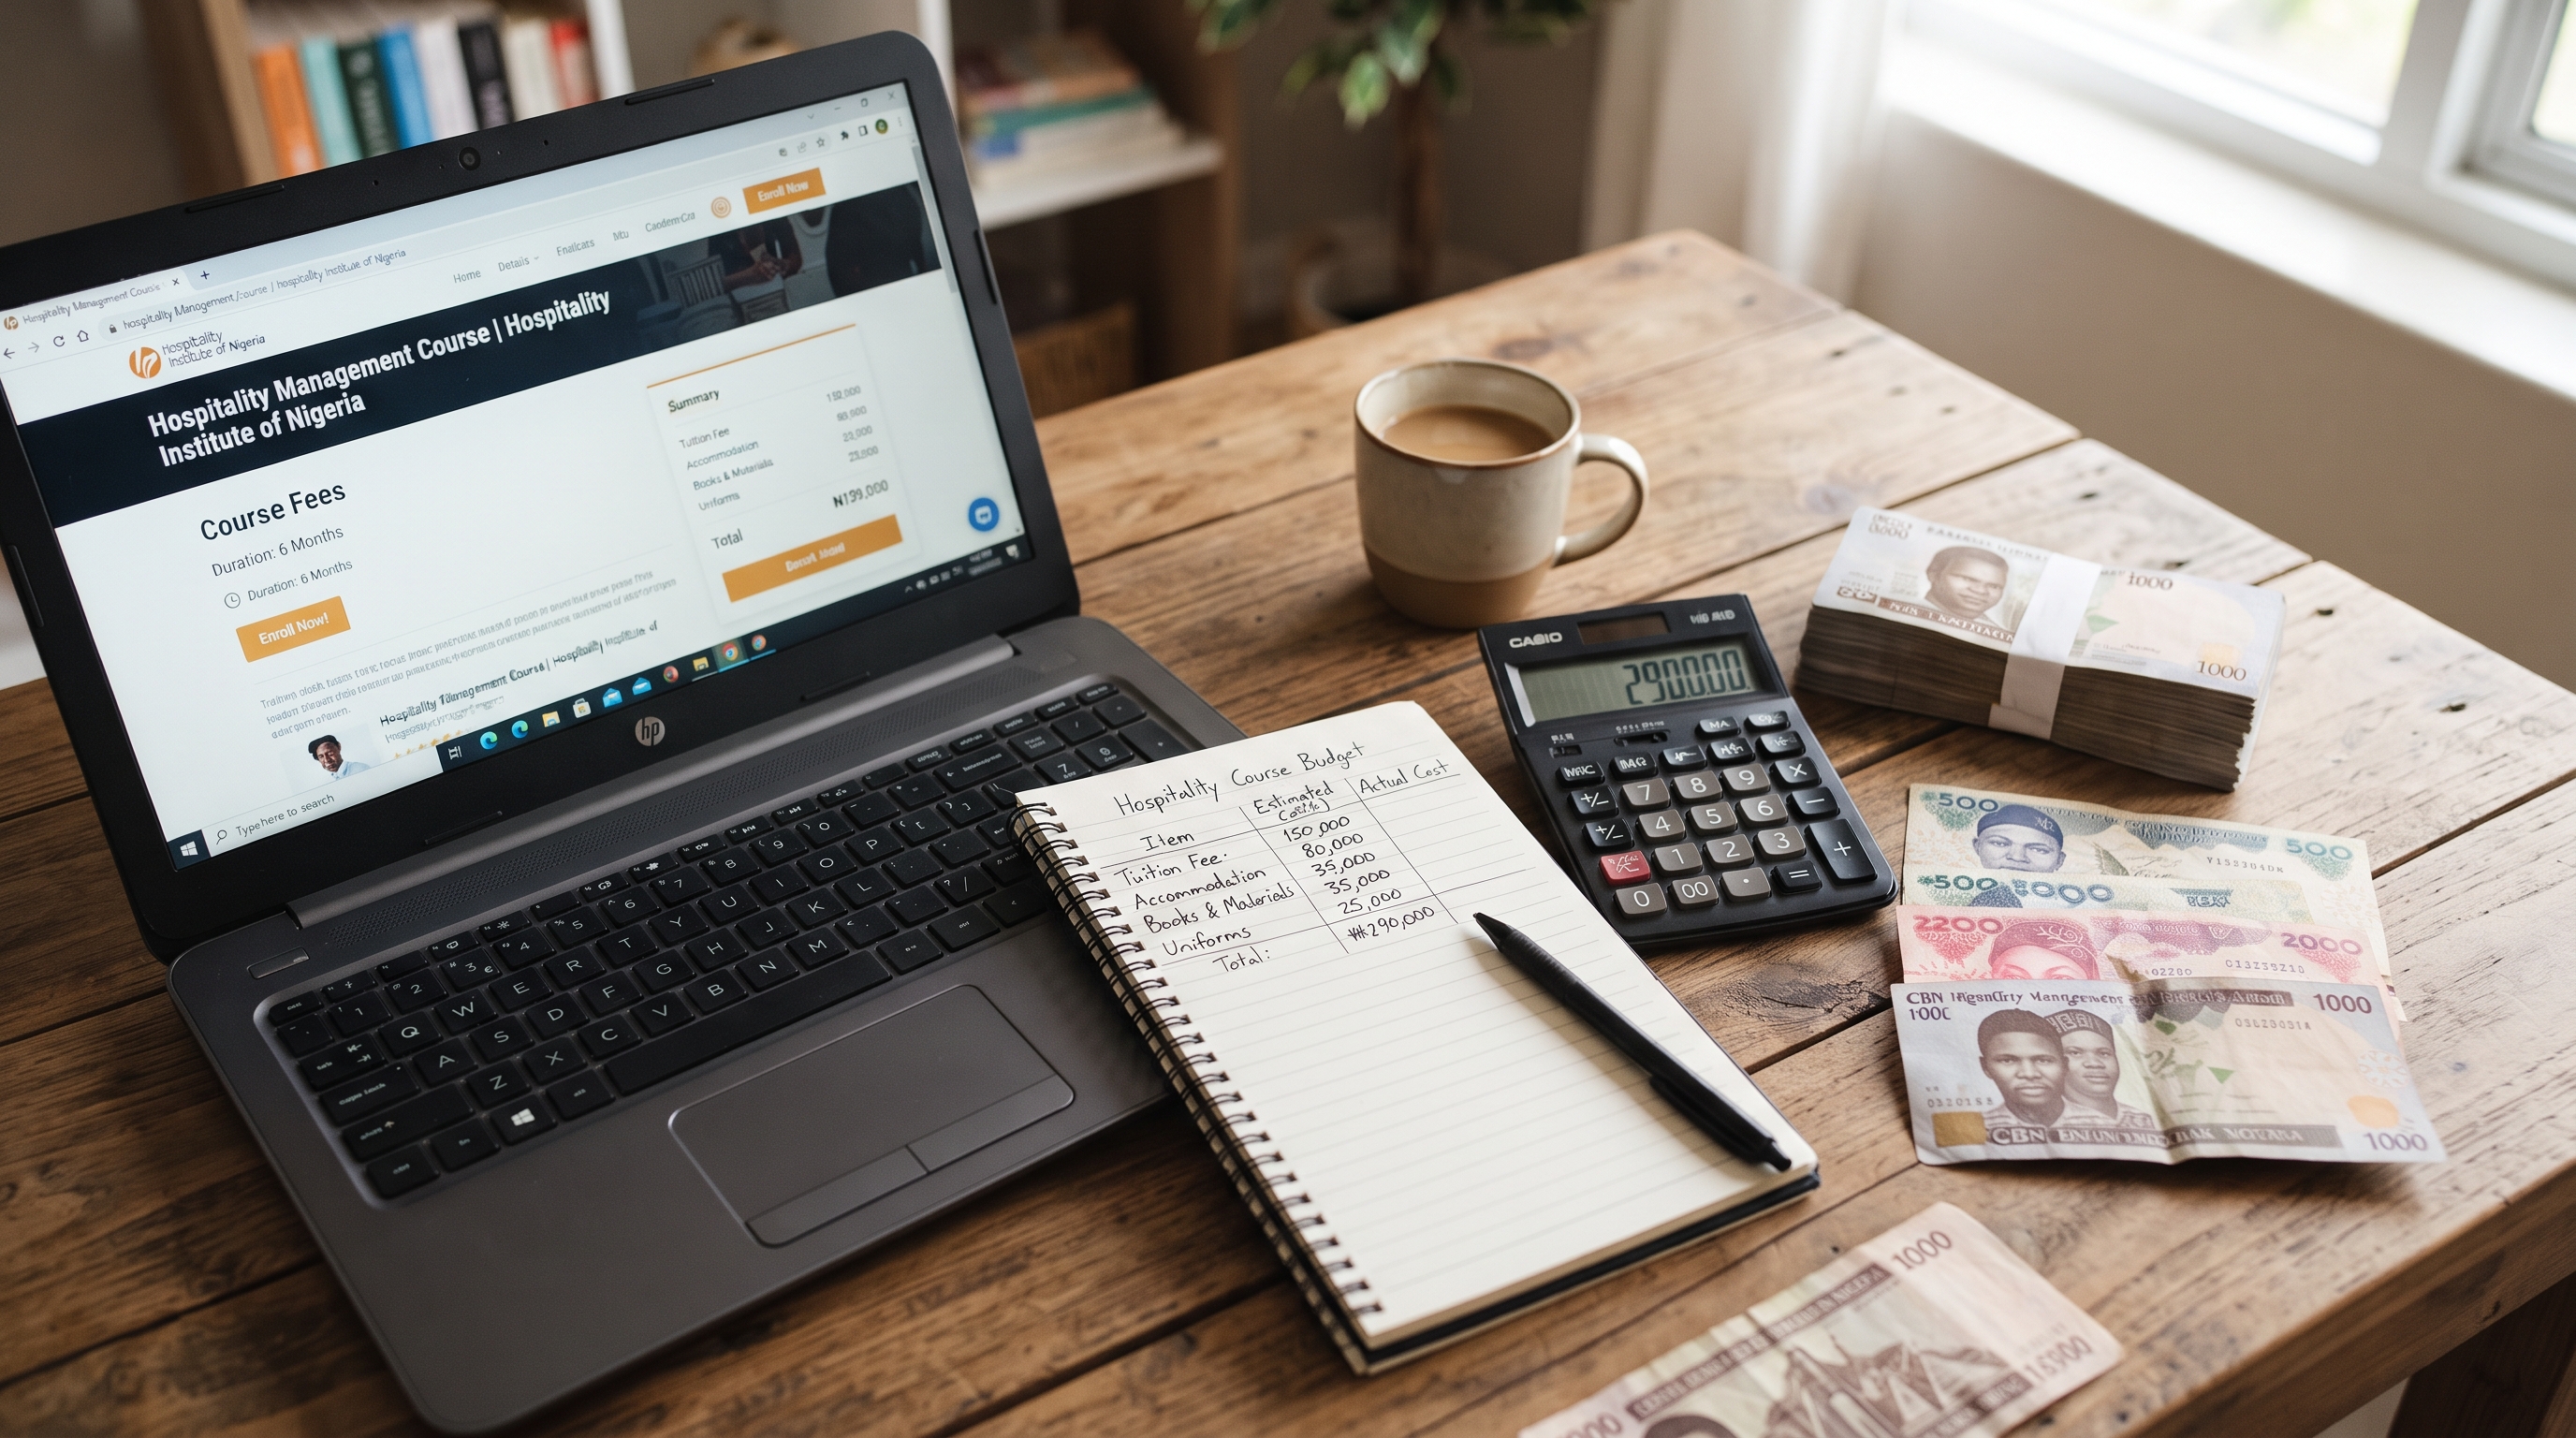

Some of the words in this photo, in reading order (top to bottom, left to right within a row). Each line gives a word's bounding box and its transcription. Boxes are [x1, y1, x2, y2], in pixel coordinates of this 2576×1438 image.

[757, 183, 785, 202] Enroll
[785, 179, 810, 195] Now
[453, 268, 482, 284] Home
[498, 256, 531, 272] Details
[161, 330, 224, 357] Hospitality
[215, 341, 227, 355] of
[228, 333, 267, 353] Nigeria
[147, 384, 271, 438] Hospitality
[272, 344, 416, 404] Management
[416, 321, 491, 361] Course
[503, 288, 612, 337] Hospitality
[667, 389, 721, 414] Summary
[157, 428, 257, 467] Institute
[258, 412, 284, 439] of
[285, 391, 367, 432] Nigeria
[712, 426, 730, 439] Fee
[199, 503, 286, 541] Course
[287, 483, 347, 515] Fees
[211, 548, 277, 577] Duration:
[278, 542, 289, 557] 6
[290, 526, 344, 553] Months
[710, 528, 744, 550] Total
[247, 578, 299, 602] Duration:
[300, 573, 309, 585] 6
[310, 559, 354, 581] Months
[257, 622, 296, 646] Enroll
[296, 611, 330, 633] Now!
[2196, 659, 2247, 682] 1000
[640, 718, 661, 741] hp
[1112, 778, 1220, 816] Hospitality
[1231, 766, 1293, 786] Course
[1296, 741, 1366, 770] Budget
[1637, 784, 1651, 801] 7
[1690, 777, 1707, 794] 8
[1738, 770, 1756, 785] 9
[1139, 832, 1195, 852] Item
[1253, 780, 1335, 815] Estimated
[1359, 769, 1410, 795] Actual
[1655, 814, 1672, 832] 4
[1705, 808, 1722, 825] 5
[1757, 800, 1774, 816] 6
[1938, 791, 1999, 813] 500
[235, 820, 261, 841] Type
[260, 812, 285, 829] here
[285, 806, 299, 818] to
[300, 792, 336, 814] search
[1283, 815, 1351, 843] 150,000
[1671, 847, 1685, 865] 1
[1721, 841, 1741, 858] 2
[1773, 831, 1791, 849] 3
[2286, 837, 2354, 861] 500
[1134, 869, 1266, 910] Accommodation
[1301, 833, 1364, 858] 80,000
[1337, 888, 1402, 915] 25,000
[1632, 889, 1651, 908] 0
[1681, 881, 1710, 899] 00
[410, 983, 423, 994] 2
[464, 961, 477, 973] 3
[520, 942, 531, 951] 4
[572, 919, 584, 930] 5
[624, 899, 636, 909] 6
[673, 878, 683, 888] 7
[724, 858, 737, 869] 8
[772, 840, 784, 850] 9
[1143, 907, 1199, 934] Books
[1205, 901, 1221, 919] &
[1162, 926, 1251, 956] Uniforms
[1324, 869, 1390, 895] 35,000
[1912, 914, 2005, 935] 2200
[401, 1026, 421, 1038] Q
[451, 1001, 476, 1018] W
[512, 981, 531, 995] E
[565, 960, 583, 972] R
[618, 937, 633, 949] T
[669, 916, 682, 928] Y
[721, 896, 738, 908] U
[819, 858, 834, 869] O
[866, 839, 878, 850] P
[2279, 932, 2364, 957] 2000
[1211, 945, 1271, 973] Total:
[439, 1054, 456, 1069] A
[493, 1031, 510, 1043] S
[547, 1007, 564, 1021] D
[601, 985, 617, 999] F
[656, 963, 673, 976] G
[707, 942, 724, 955] H
[765, 921, 775, 933] J
[807, 901, 826, 914] K
[856, 883, 872, 892] L
[1905, 990, 1944, 1005] CBN
[2313, 992, 2373, 1014] 1000
[489, 1075, 508, 1091] Z
[545, 1050, 564, 1066] X
[601, 1028, 619, 1042] C
[651, 1004, 668, 1018] V
[707, 983, 725, 997] B
[758, 960, 778, 974] N
[808, 938, 827, 953] M
[1991, 1127, 2047, 1145] CBN
[2362, 1131, 2430, 1152] 1000
[1891, 1230, 1953, 1271] 1000
